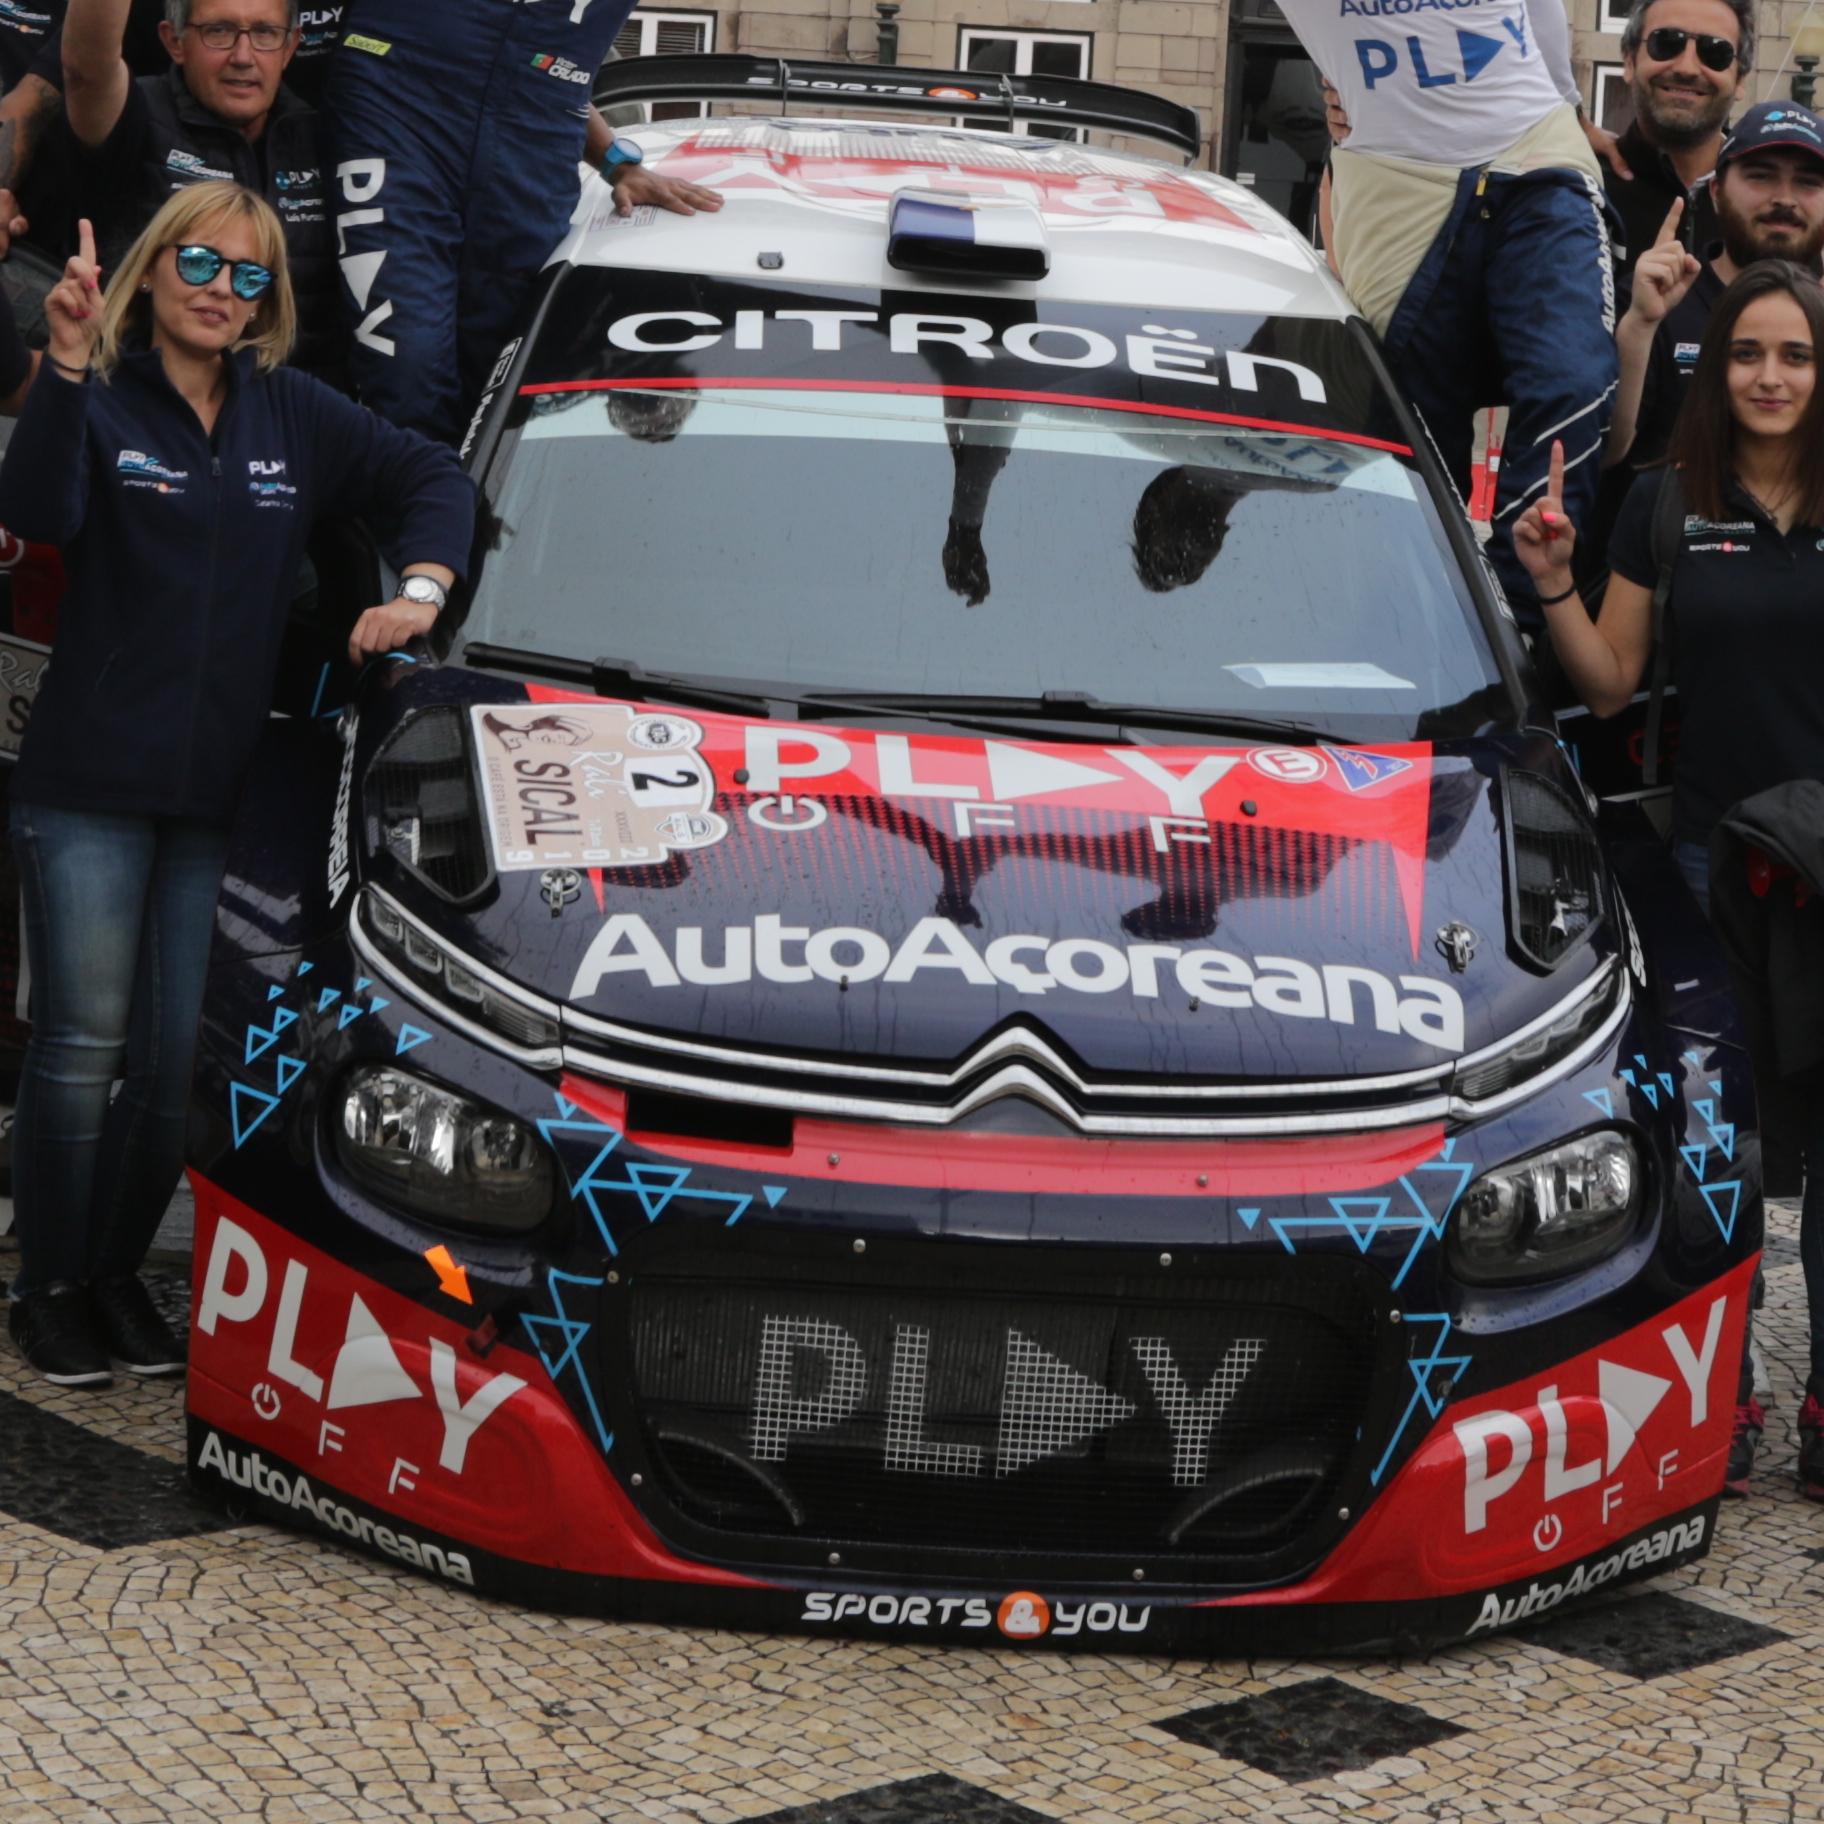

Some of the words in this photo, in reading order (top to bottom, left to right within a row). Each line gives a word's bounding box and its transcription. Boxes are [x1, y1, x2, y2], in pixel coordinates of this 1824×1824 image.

[606, 307, 1328, 404] CITROËN
[512, 759, 584, 846] SICAL
[630, 769, 700, 792] 2
